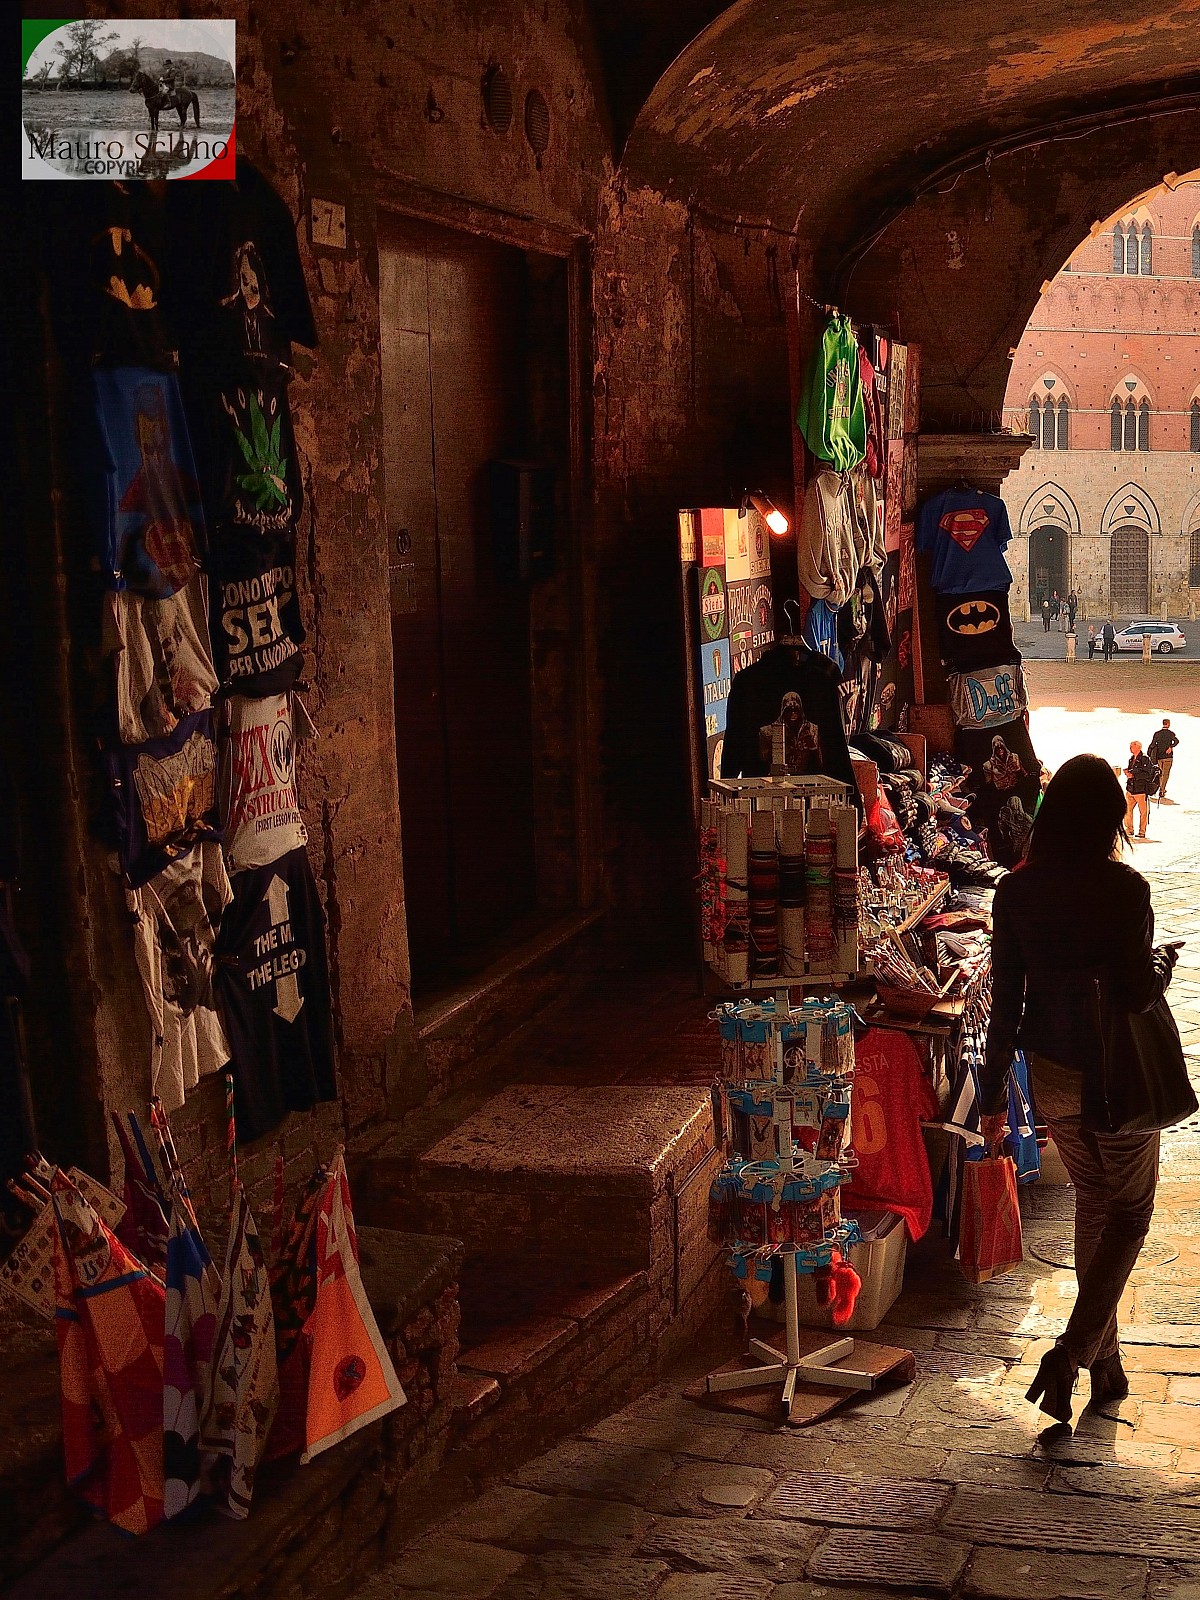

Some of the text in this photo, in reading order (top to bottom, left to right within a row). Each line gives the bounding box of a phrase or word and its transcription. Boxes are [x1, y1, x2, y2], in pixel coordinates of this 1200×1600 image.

[704, 596, 725, 612] Siena
[752, 630, 775, 648] SIENA
[229, 655, 255, 677] PER
[966, 673, 1015, 721] Duff
[253, 928, 278, 958] THE
[246, 960, 272, 992] THE
